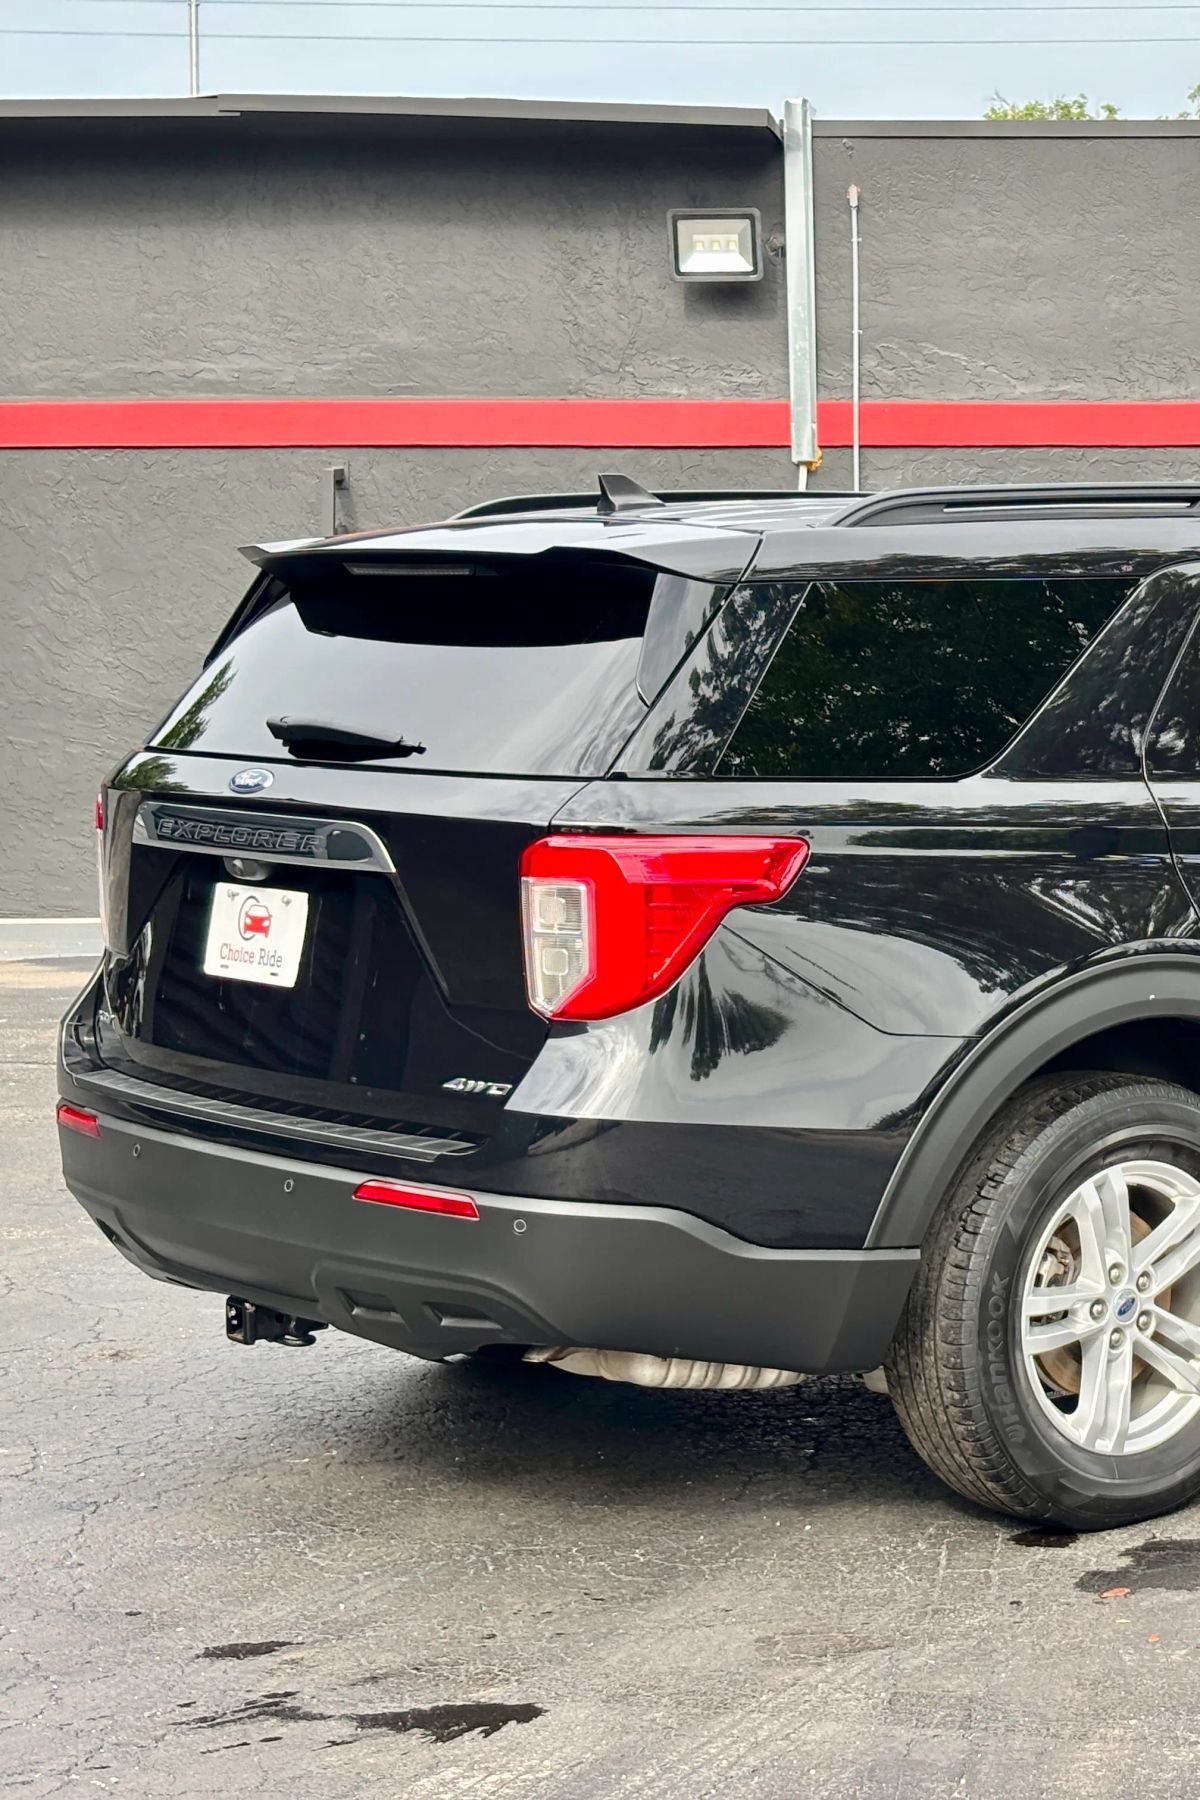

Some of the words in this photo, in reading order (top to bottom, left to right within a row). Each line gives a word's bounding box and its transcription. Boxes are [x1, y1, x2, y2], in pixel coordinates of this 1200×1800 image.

[157, 818, 326, 852] EXPLORER
[219, 942, 255, 965] Choice
[257, 947, 283, 969] Ride
[441, 1077, 513, 1096] 4WD
